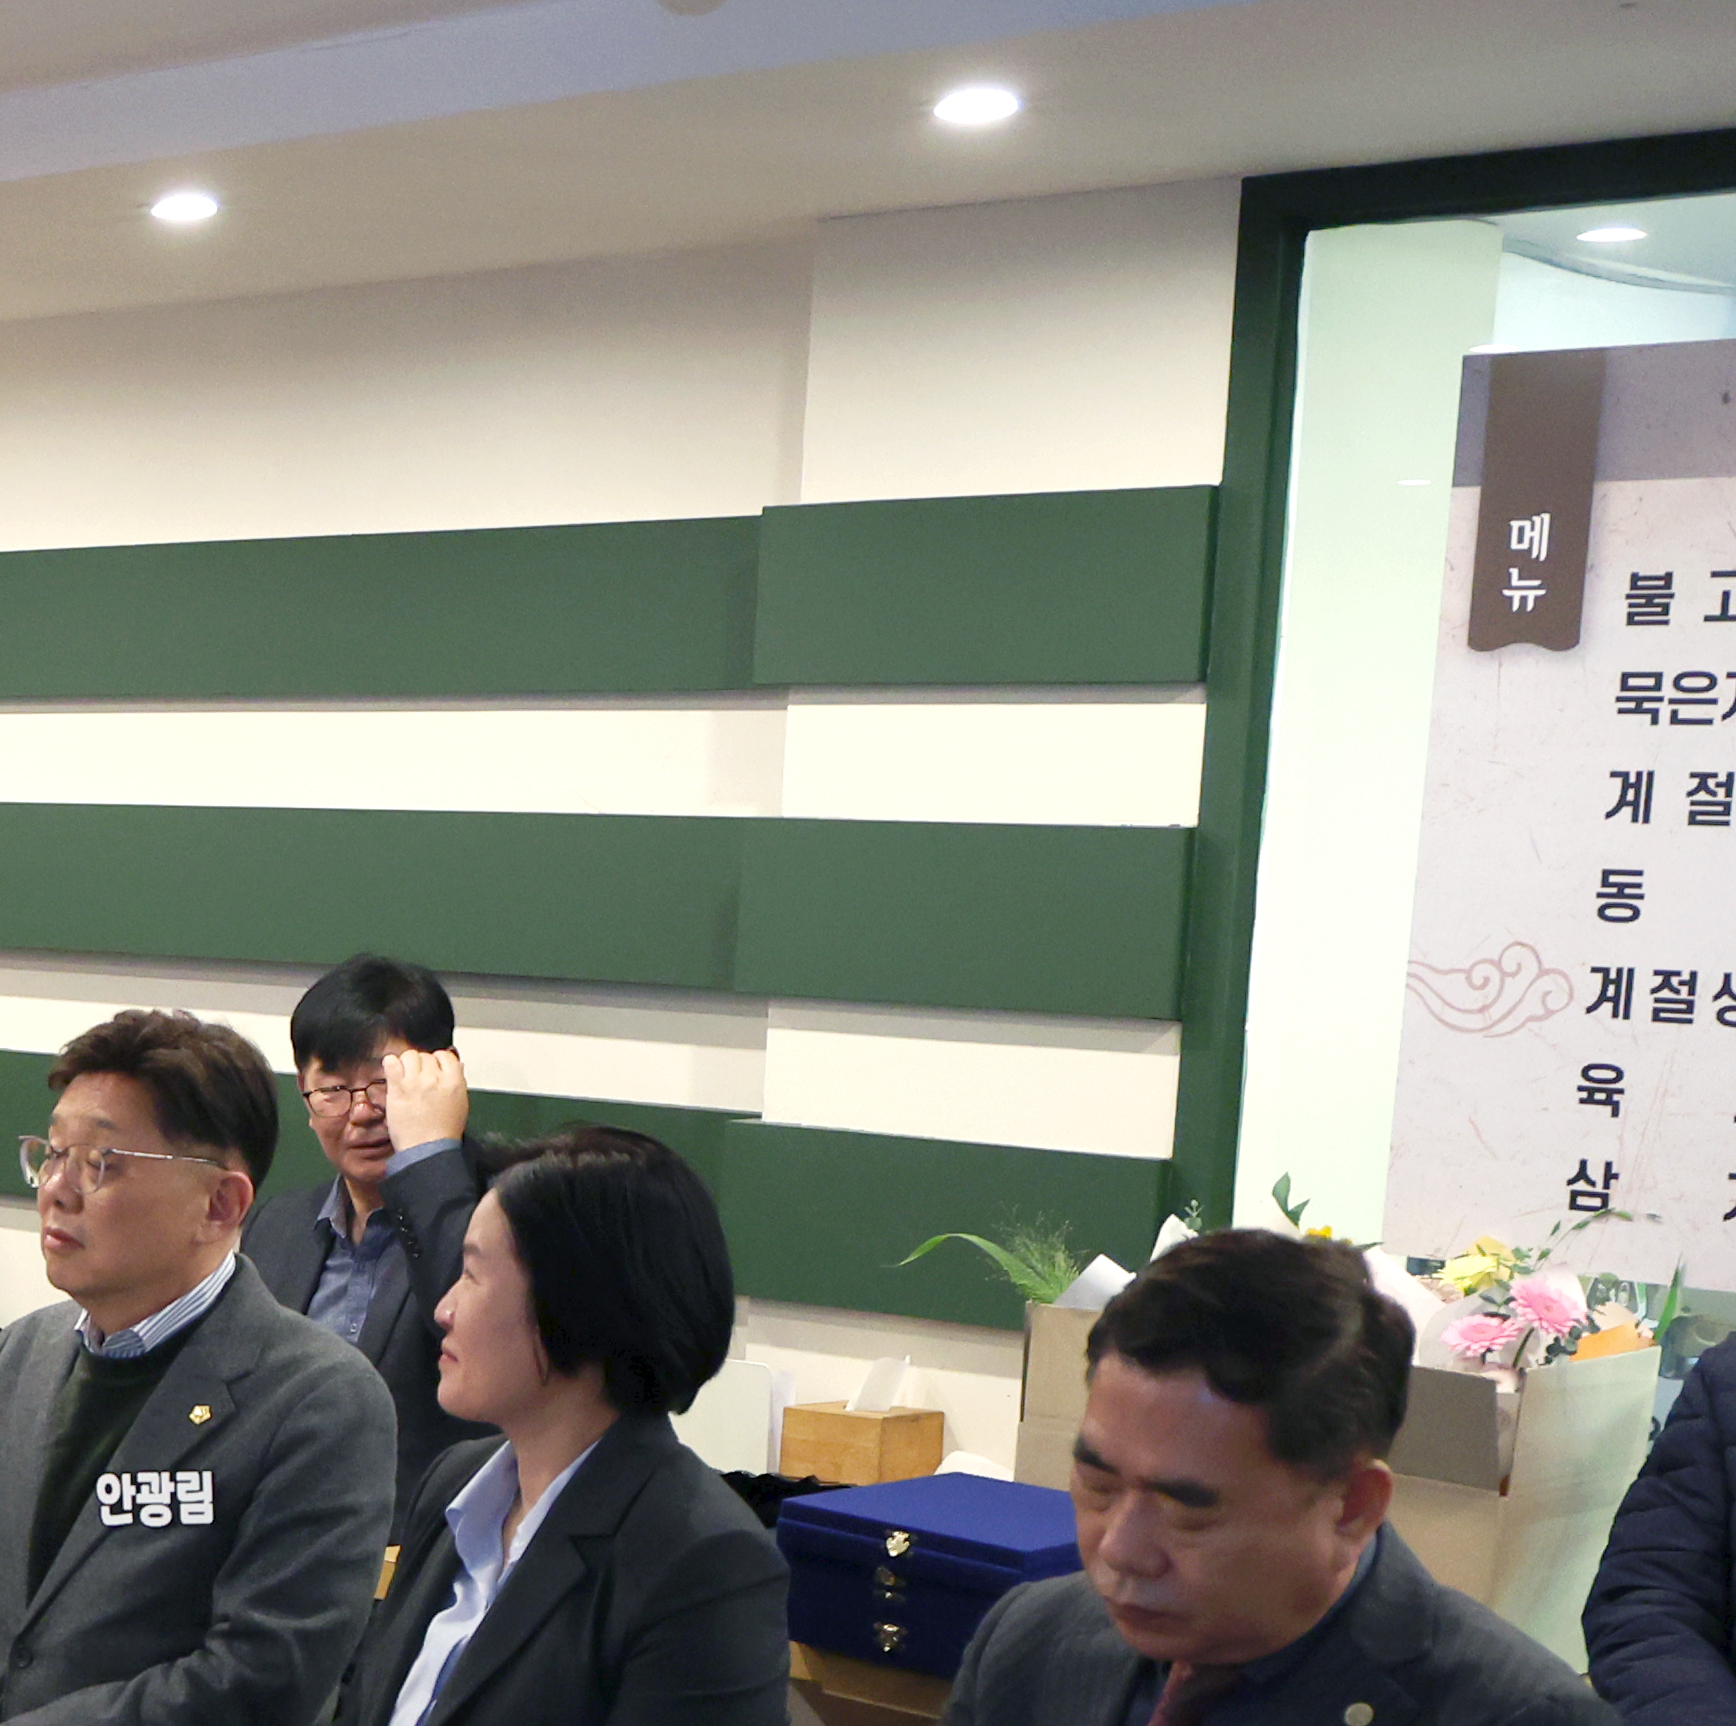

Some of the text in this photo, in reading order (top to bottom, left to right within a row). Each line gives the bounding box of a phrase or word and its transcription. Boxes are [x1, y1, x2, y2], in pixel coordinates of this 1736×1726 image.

[1502, 513, 1551, 612] 메뉴
[1596, 869, 1645, 923] 동
[1577, 1063, 1625, 1118] 육
[1566, 1158, 1619, 1212] 삼
[97, 1469, 214, 1526] 안광림
